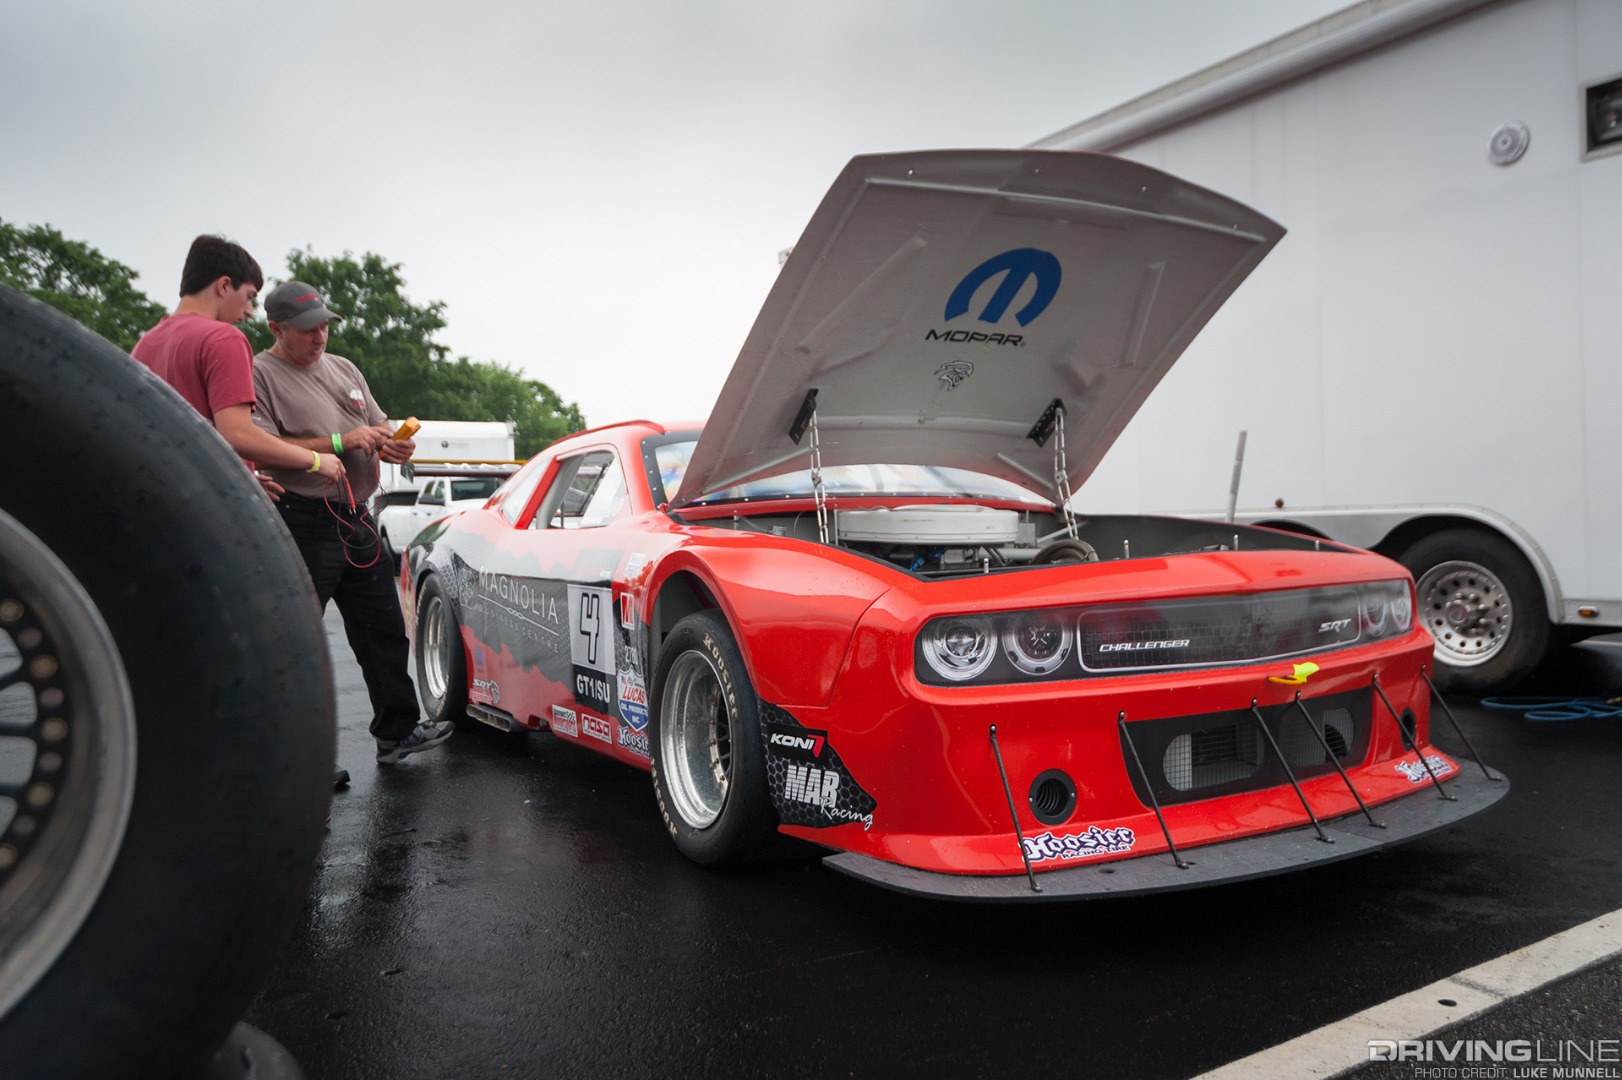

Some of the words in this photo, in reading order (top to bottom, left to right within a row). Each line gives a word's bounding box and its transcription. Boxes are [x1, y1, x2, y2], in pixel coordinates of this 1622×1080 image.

[925, 329, 1023, 346] MOPAR
[478, 566, 559, 625] MAGNOLIA
[579, 592, 600, 664] 4
[1318, 618, 1352, 632] SRT
[522, 626, 559, 653] CENTRE
[1099, 638, 1190, 652] CHALLENGER
[622, 686, 646, 705] LUCAS
[583, 715, 610, 737] nasa
[770, 733, 815, 750] KONI
[784, 764, 840, 808] MAR
[819, 796, 873, 831] Racing
[1022, 826, 1134, 861] Hoosier
[1062, 848, 1103, 859] RACING
[1106, 845, 1130, 854] TIRE
